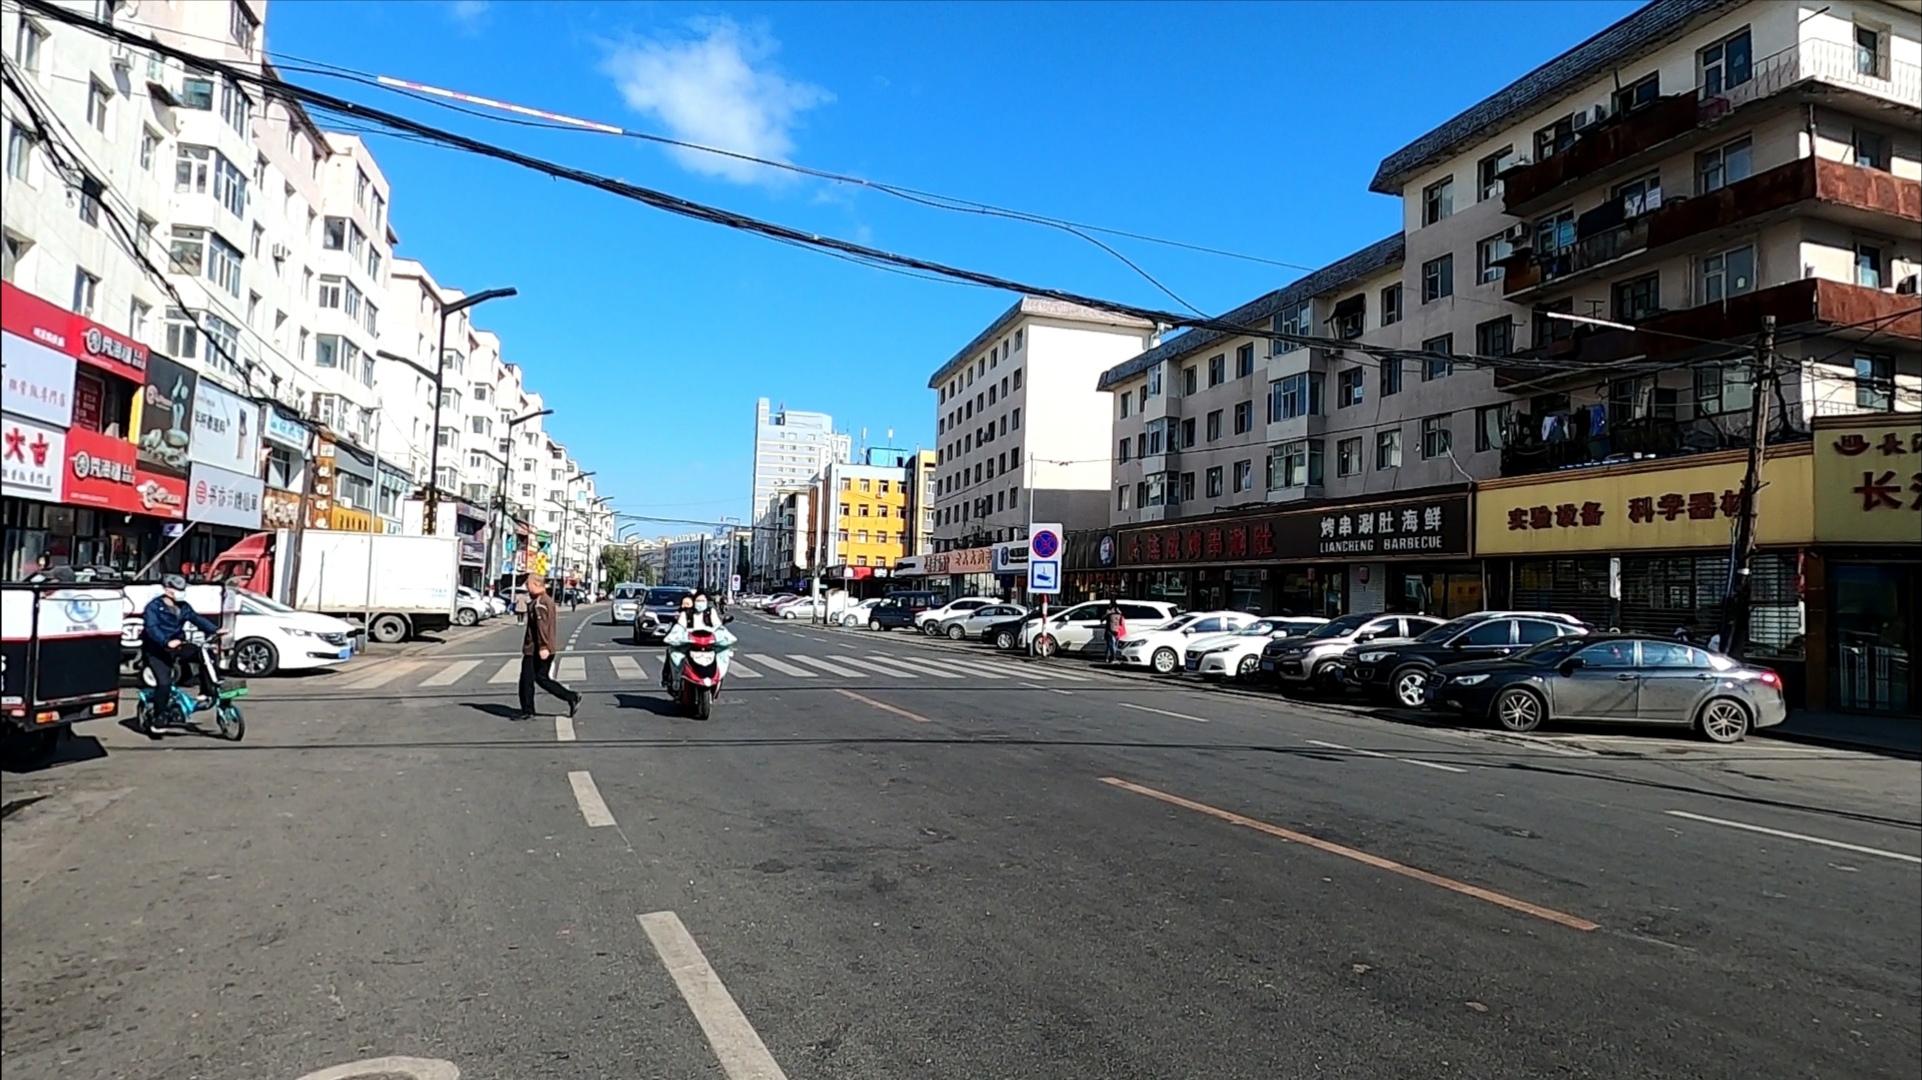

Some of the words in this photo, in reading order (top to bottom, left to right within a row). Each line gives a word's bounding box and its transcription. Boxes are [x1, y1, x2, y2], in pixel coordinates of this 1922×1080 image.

[1320, 506, 1442, 538] 烤串涮肚海鲜
[1508, 501, 1604, 530] 实验设备
[1320, 540, 1374, 553] LIANCHENG
[1383, 536, 1443, 550] BARBECUE
